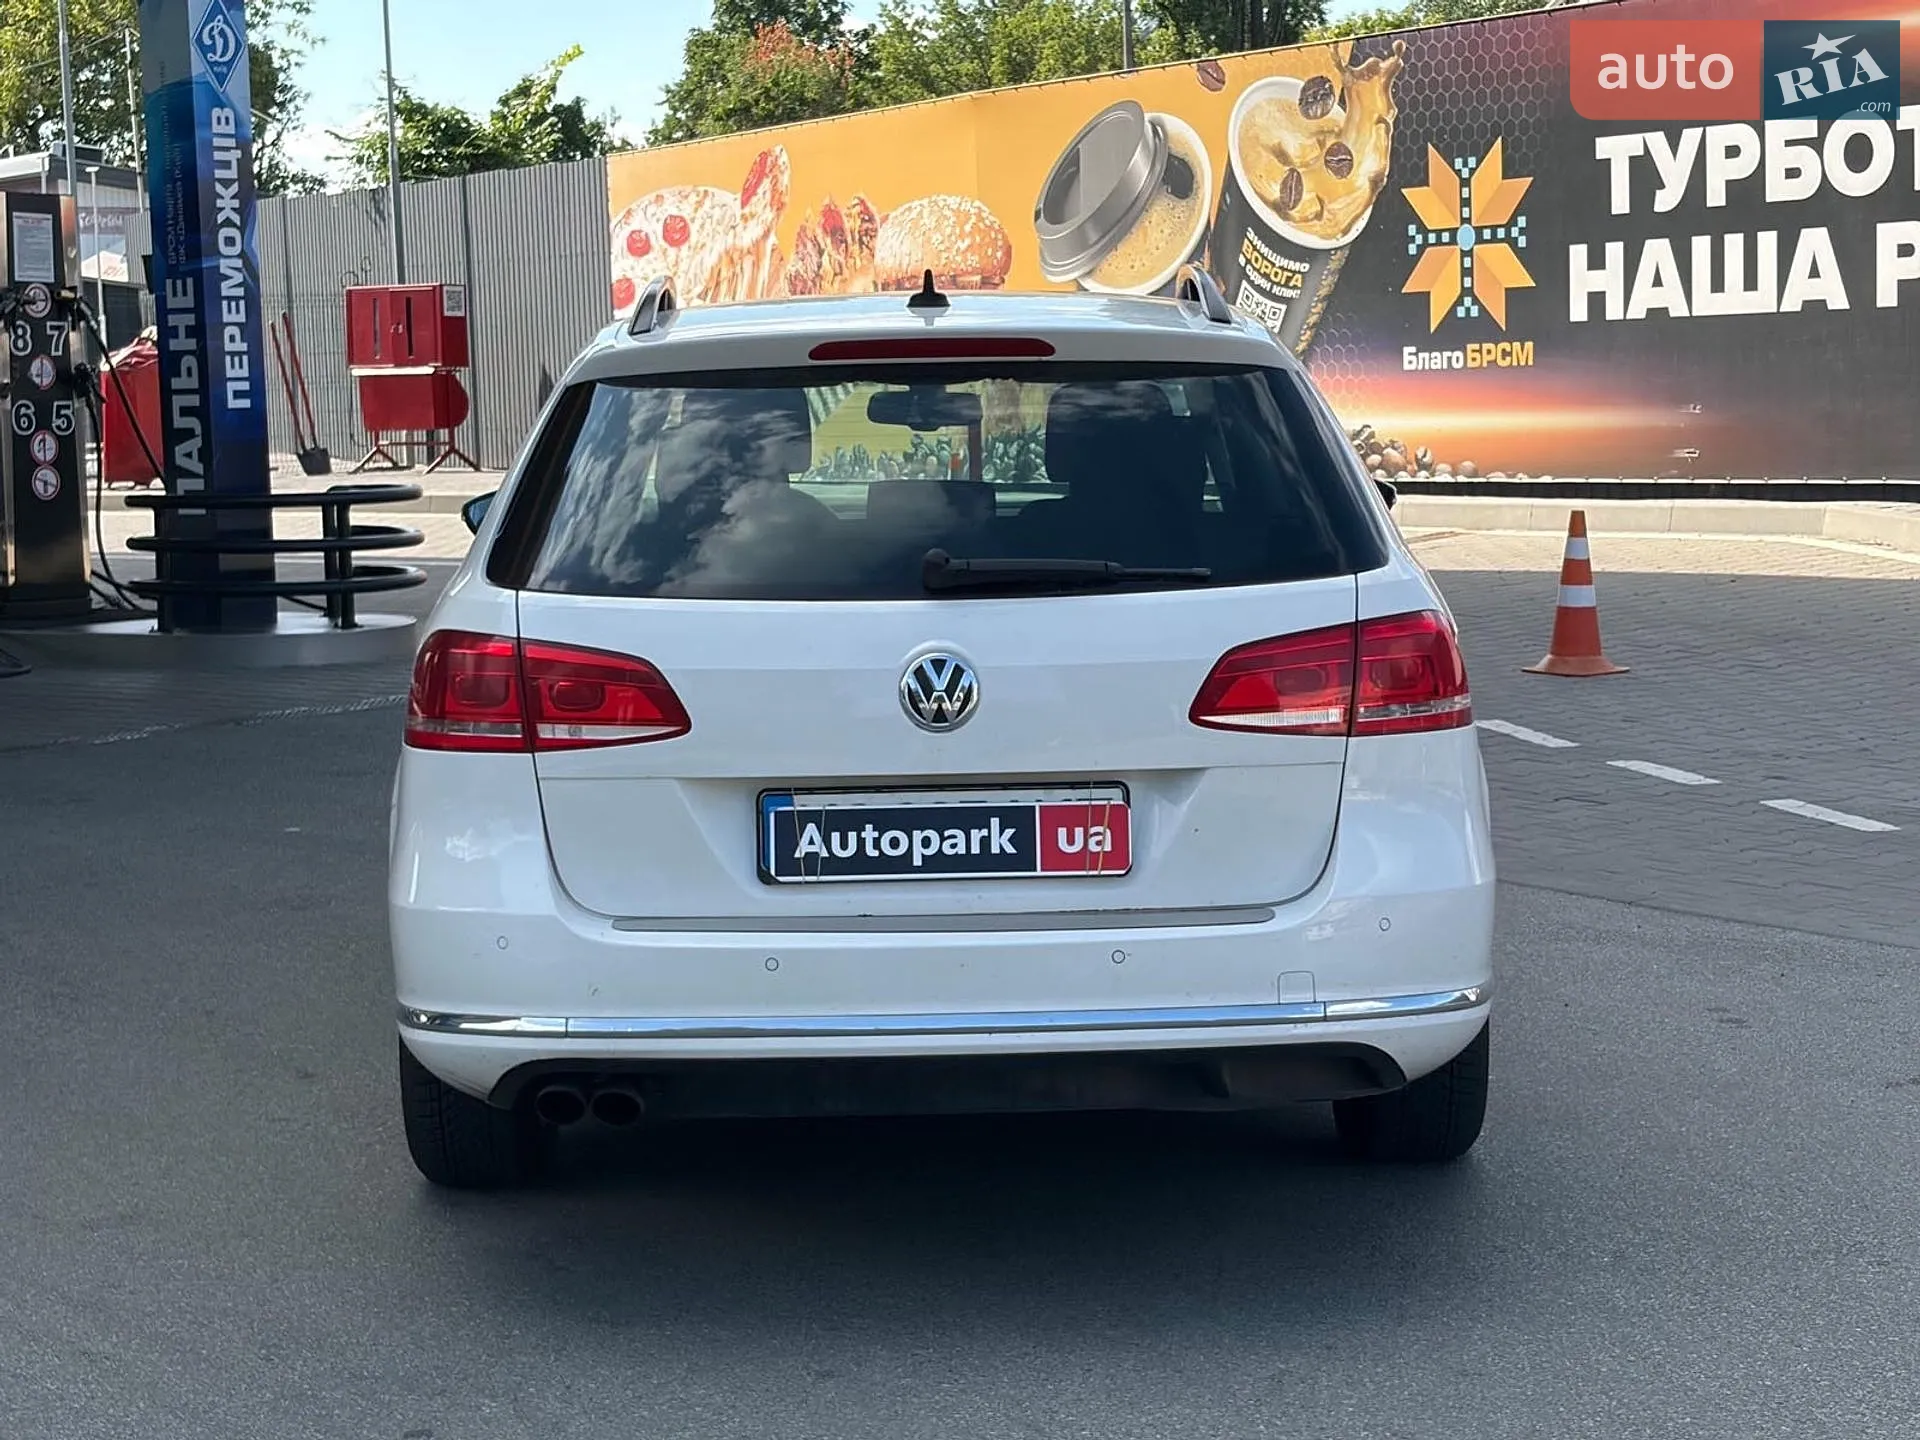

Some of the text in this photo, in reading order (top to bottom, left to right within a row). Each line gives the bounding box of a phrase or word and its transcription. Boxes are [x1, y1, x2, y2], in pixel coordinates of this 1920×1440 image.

[211, 107, 251, 409] ПЕРЕМОЖЦІВ
[1242, 237, 1303, 288] ВОРОГА
[1569, 226, 1850, 323] НАША
[10, 320, 68, 356] 8 7
[1402, 341, 1534, 371] БлагоБРСМ
[12, 399, 75, 436] 6 5
[793, 817, 1112, 867] Autopark ua
